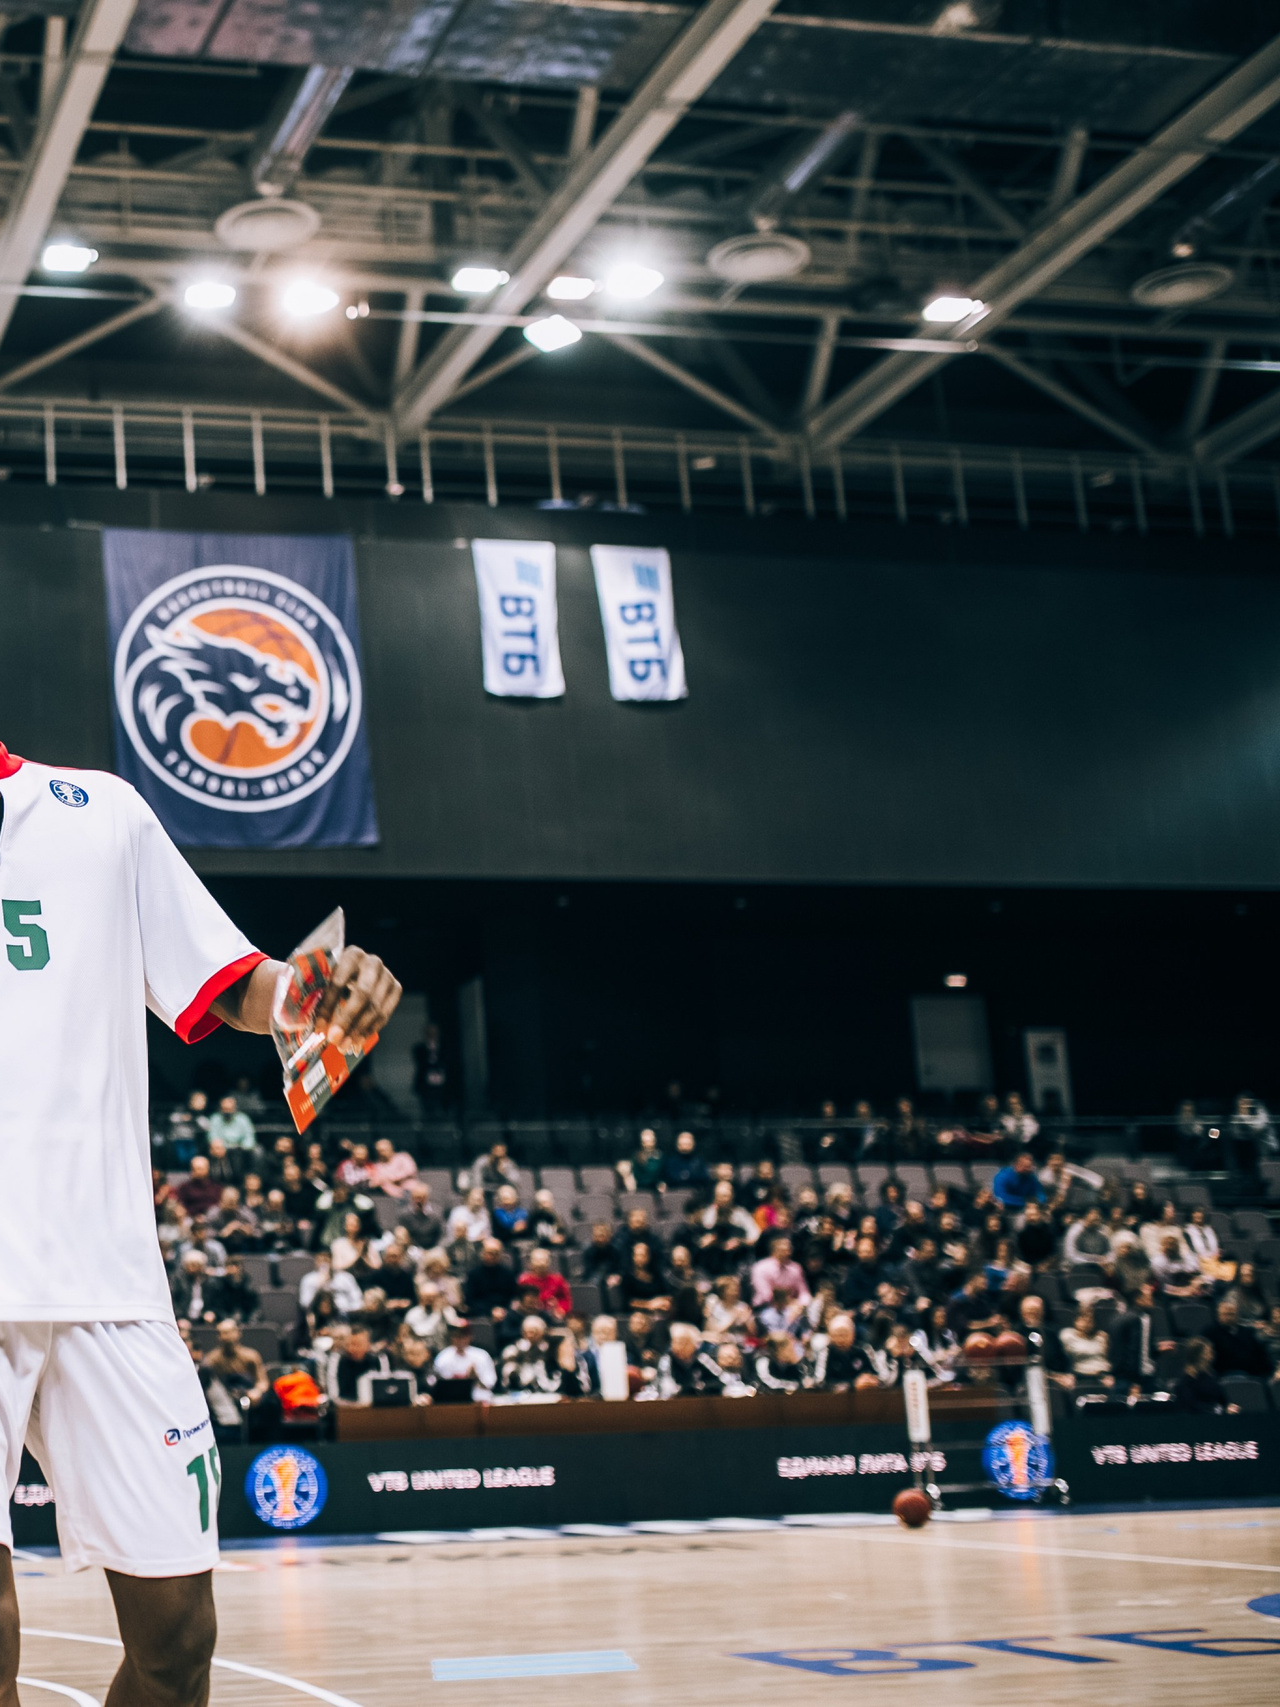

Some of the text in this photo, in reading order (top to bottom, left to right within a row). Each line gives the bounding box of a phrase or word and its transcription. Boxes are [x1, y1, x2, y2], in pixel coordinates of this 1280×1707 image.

[499, 594, 541, 678] ВТБ
[620, 601, 670, 682] ВТБ
[367, 1465, 556, 1492] VTB UNITED LEAGUE
